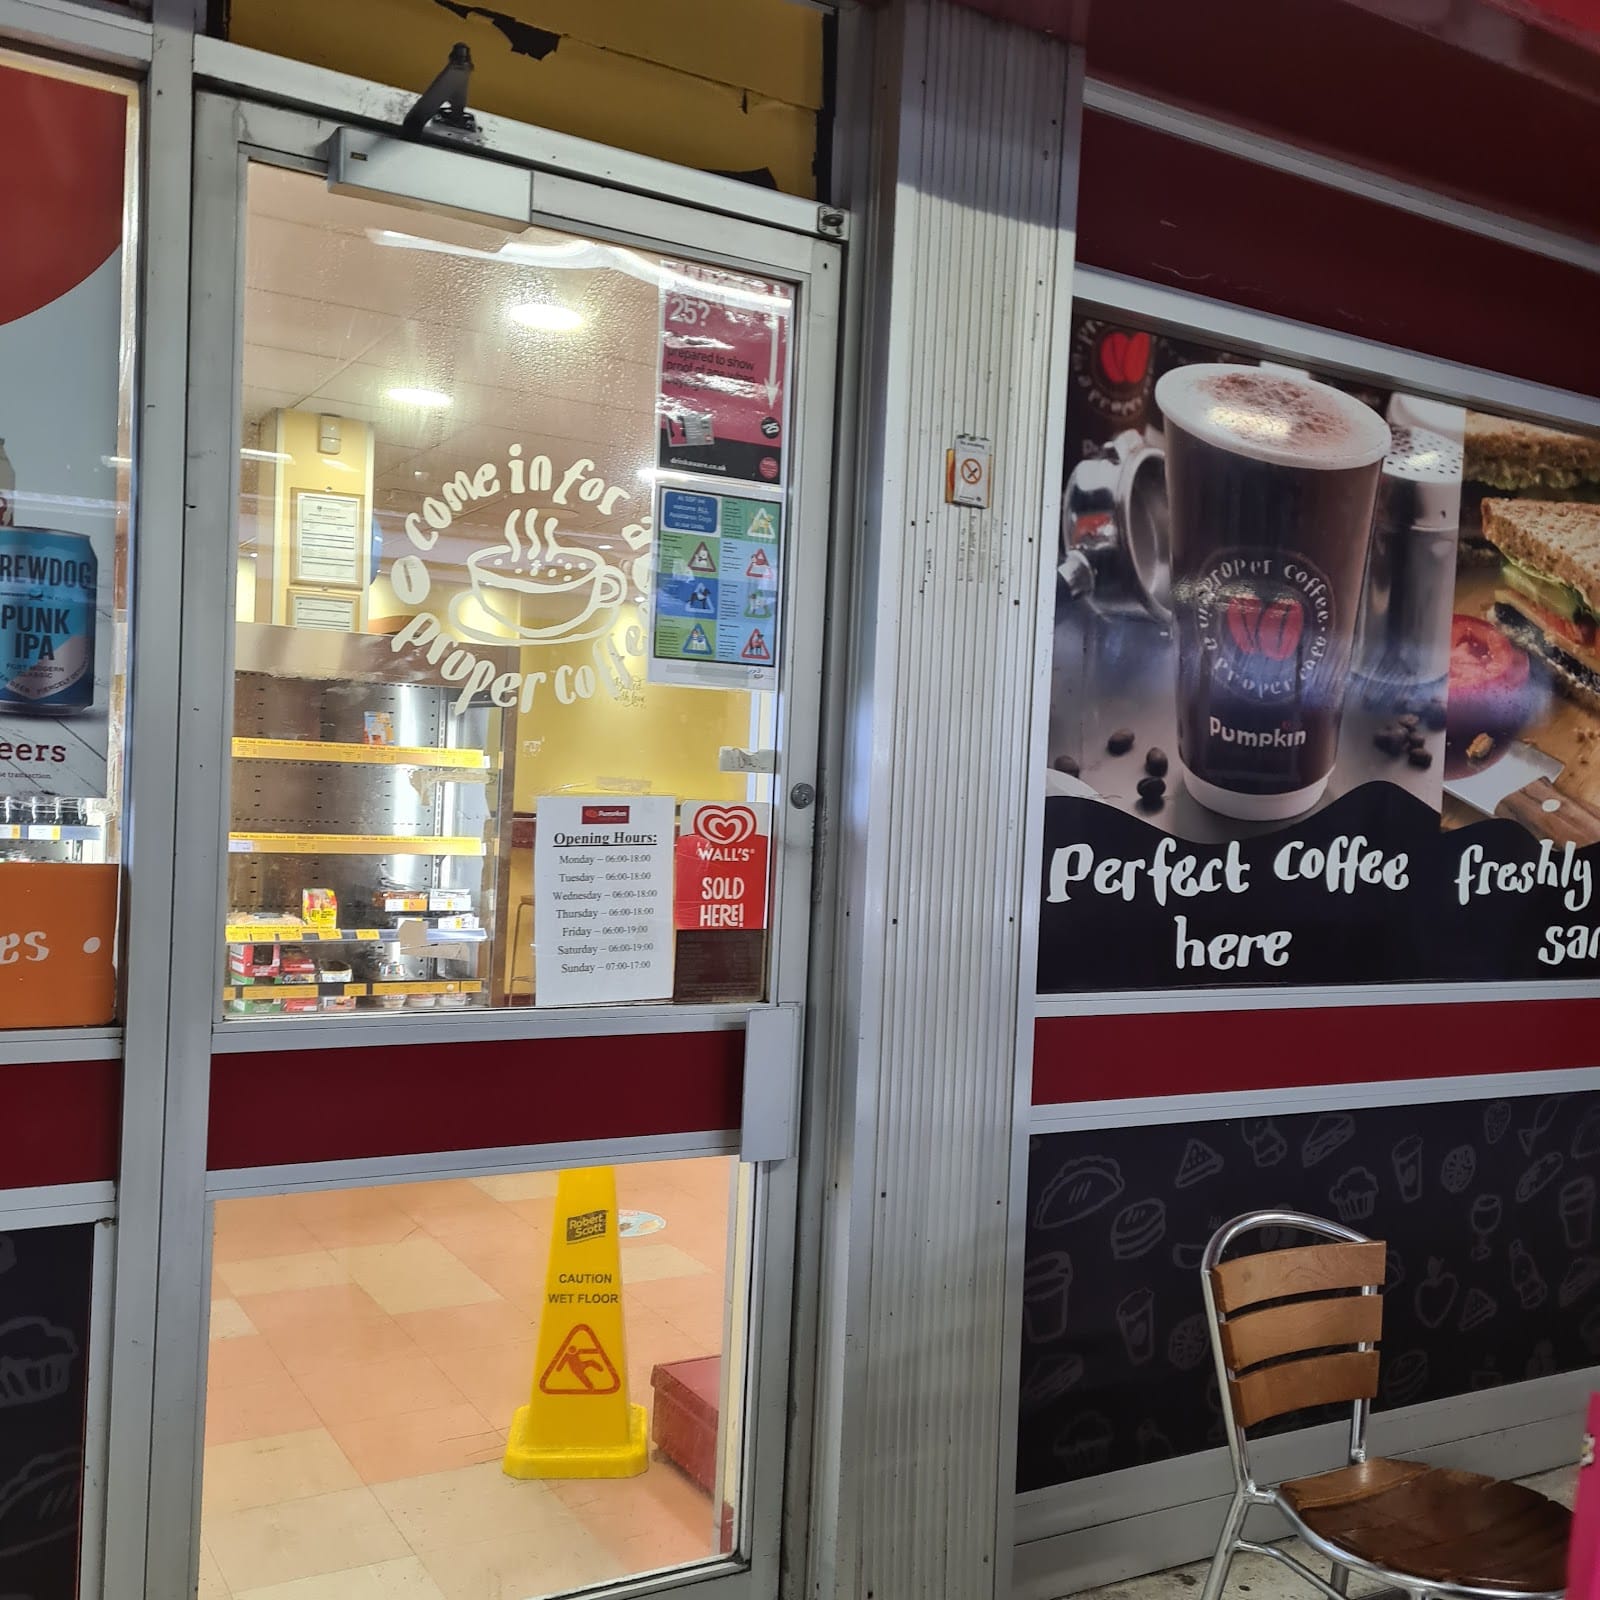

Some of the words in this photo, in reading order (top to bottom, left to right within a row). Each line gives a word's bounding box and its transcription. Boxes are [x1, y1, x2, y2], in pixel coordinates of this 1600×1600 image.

[669, 299, 711, 327] 25?
[716, 353, 725, 366] to
[727, 357, 754, 370] show
[405, 463, 500, 551] come
[508, 443, 553, 494] in
[553, 458, 631, 515] for
[1283, 564, 1328, 623] coffee
[1, 604, 70, 635] PUNK
[15, 633, 55, 660] IPA
[392, 612, 547, 716] proper
[1209, 715, 1307, 748] Pumpkin
[553, 832, 609, 846] Opening
[614, 831, 658, 844] Hours:
[559, 855, 595, 866] Monday
[605, 854, 651, 863] 06:00-18:00
[698, 848, 750, 862] WALL'S
[559, 873, 595, 884] Tuesday
[605, 872, 651, 881] 06:00-18:00
[1046, 837, 1251, 907] Perfect
[1454, 838, 1593, 912] freshly
[552, 891, 602, 902] Wednesday
[612, 889, 658, 899] 06:00-18:00
[702, 877, 745, 900] SOLD
[556, 909, 598, 920] Thursday
[609, 907, 654, 917] 06:00-18:00
[700, 902, 744, 928] HERE!
[562, 927, 592, 937] Friday
[602, 925, 648, 935] 06:00-19:00
[557, 945, 598, 955] Saturday
[608, 942, 654, 952] 06:00-19:00
[1173, 915, 1293, 971] here
[561, 963, 596, 974] Sunday
[605, 961, 651, 970] 07:00-17:00
[569, 1213, 604, 1230] Robert
[575, 1222, 604, 1238] Scott
[559, 1273, 612, 1284] CAUTION
[548, 1293, 575, 1304] WET
[578, 1293, 619, 1304] FLOOR
